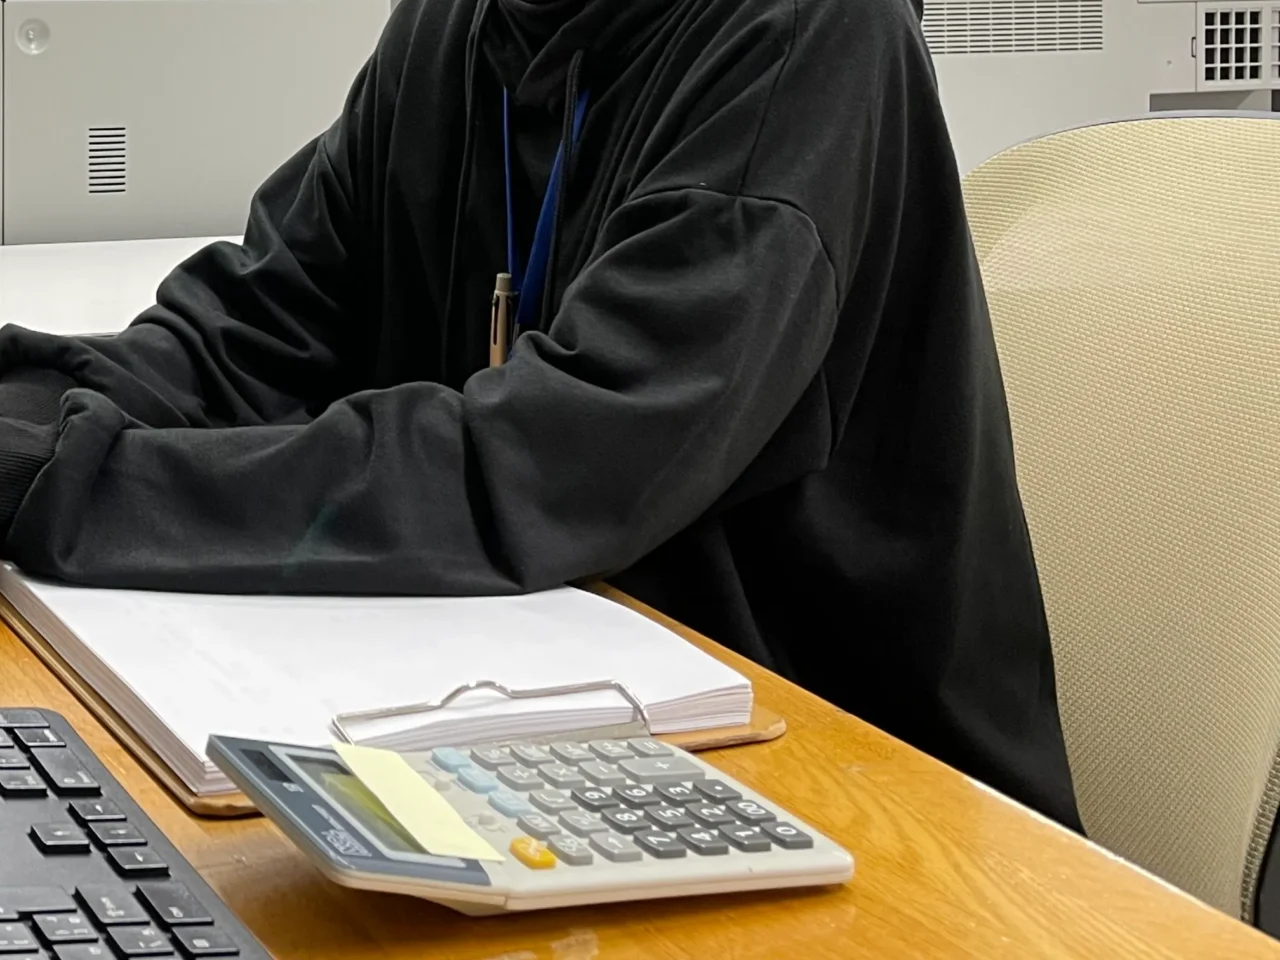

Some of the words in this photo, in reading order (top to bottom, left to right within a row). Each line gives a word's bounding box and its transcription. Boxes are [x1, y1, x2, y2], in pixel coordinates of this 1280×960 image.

[584, 791, 607, 799] 9
[625, 788, 647, 797] 6
[668, 786, 690, 795] 3
[701, 807, 724, 816] 2
[737, 802, 766, 815] 00
[615, 812, 638, 821] 8
[658, 809, 682, 818] 5
[734, 830, 755, 838] 1
[776, 826, 798, 836] 0
[646, 835, 672, 845] 7
[690, 831, 713, 841] 4
